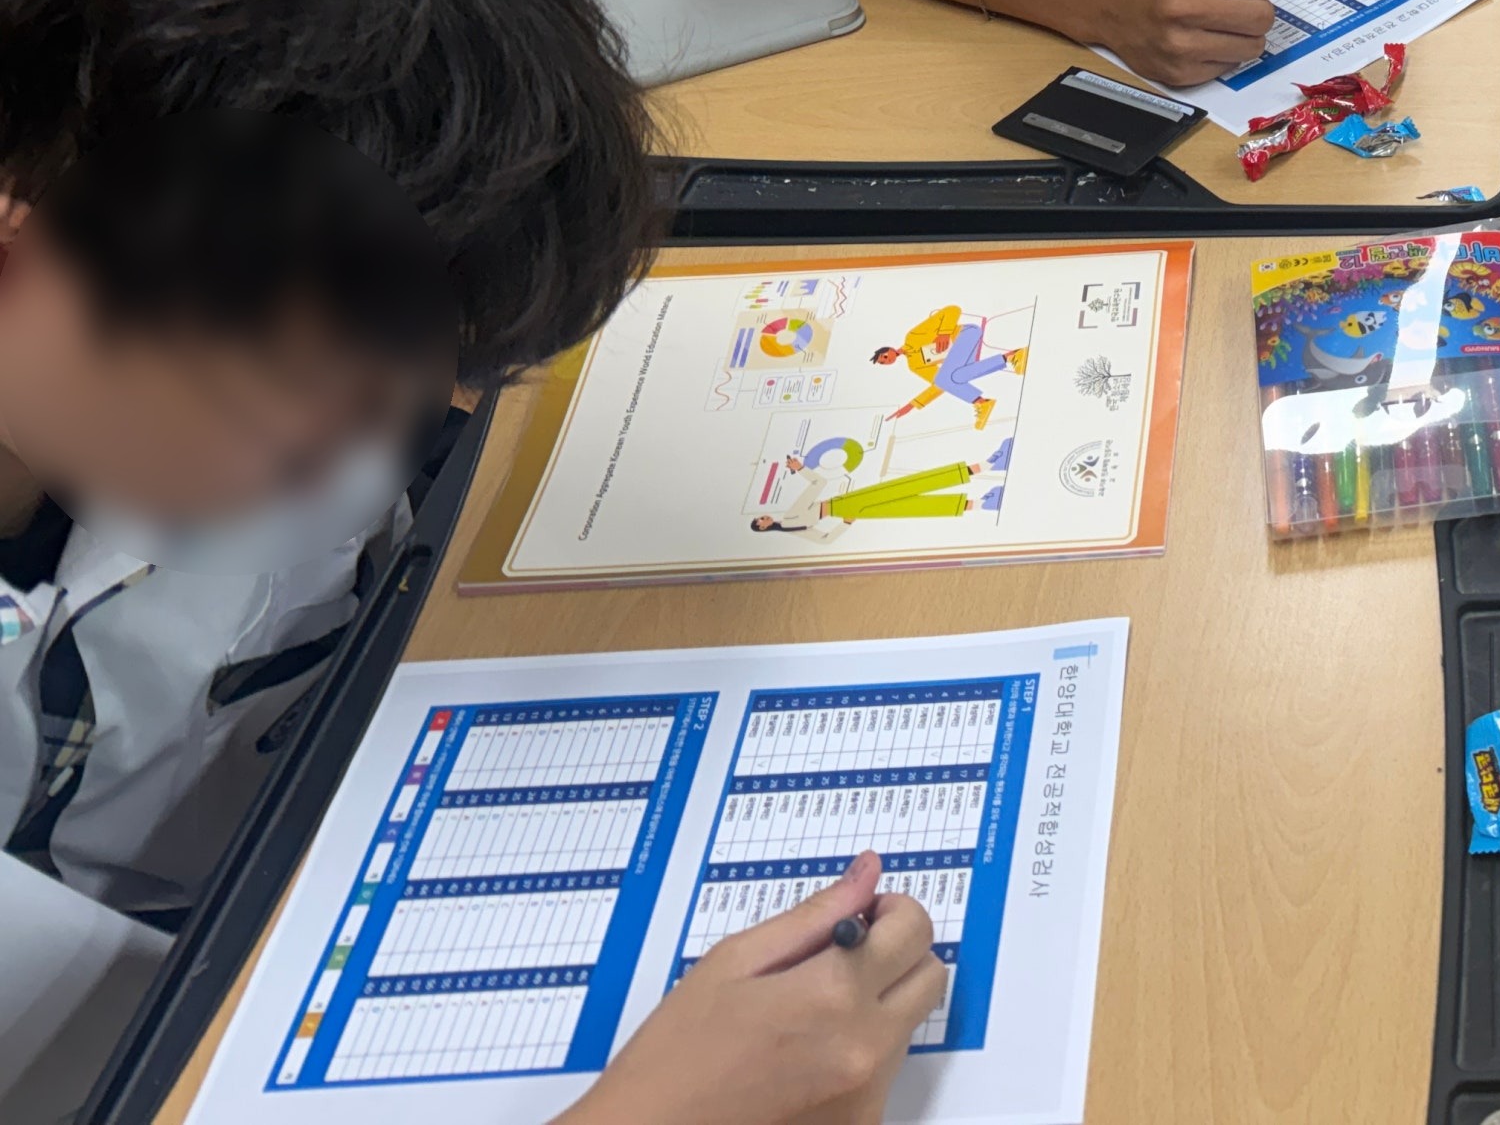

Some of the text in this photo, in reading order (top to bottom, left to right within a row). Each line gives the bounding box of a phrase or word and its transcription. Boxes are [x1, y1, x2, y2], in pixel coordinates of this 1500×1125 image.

[1338, 254, 1364, 269] 12
[646, 321, 664, 352] Education
[638, 353, 653, 377] World
[625, 377, 646, 414] Experience
[617, 414, 634, 437] Youth
[609, 437, 626, 462] Korean
[594, 462, 616, 499] Aggregate
[578, 499, 602, 542] Corporation
[772, 699, 783, 708] 14
[806, 697, 816, 706] 12
[822, 696, 832, 705] 11
[839, 695, 849, 704] 10
[1021, 678, 1036, 704] STEP
[694, 696, 713, 721] STEP
[1026, 664, 1081, 900] 한양대학교 전공적합성검사
